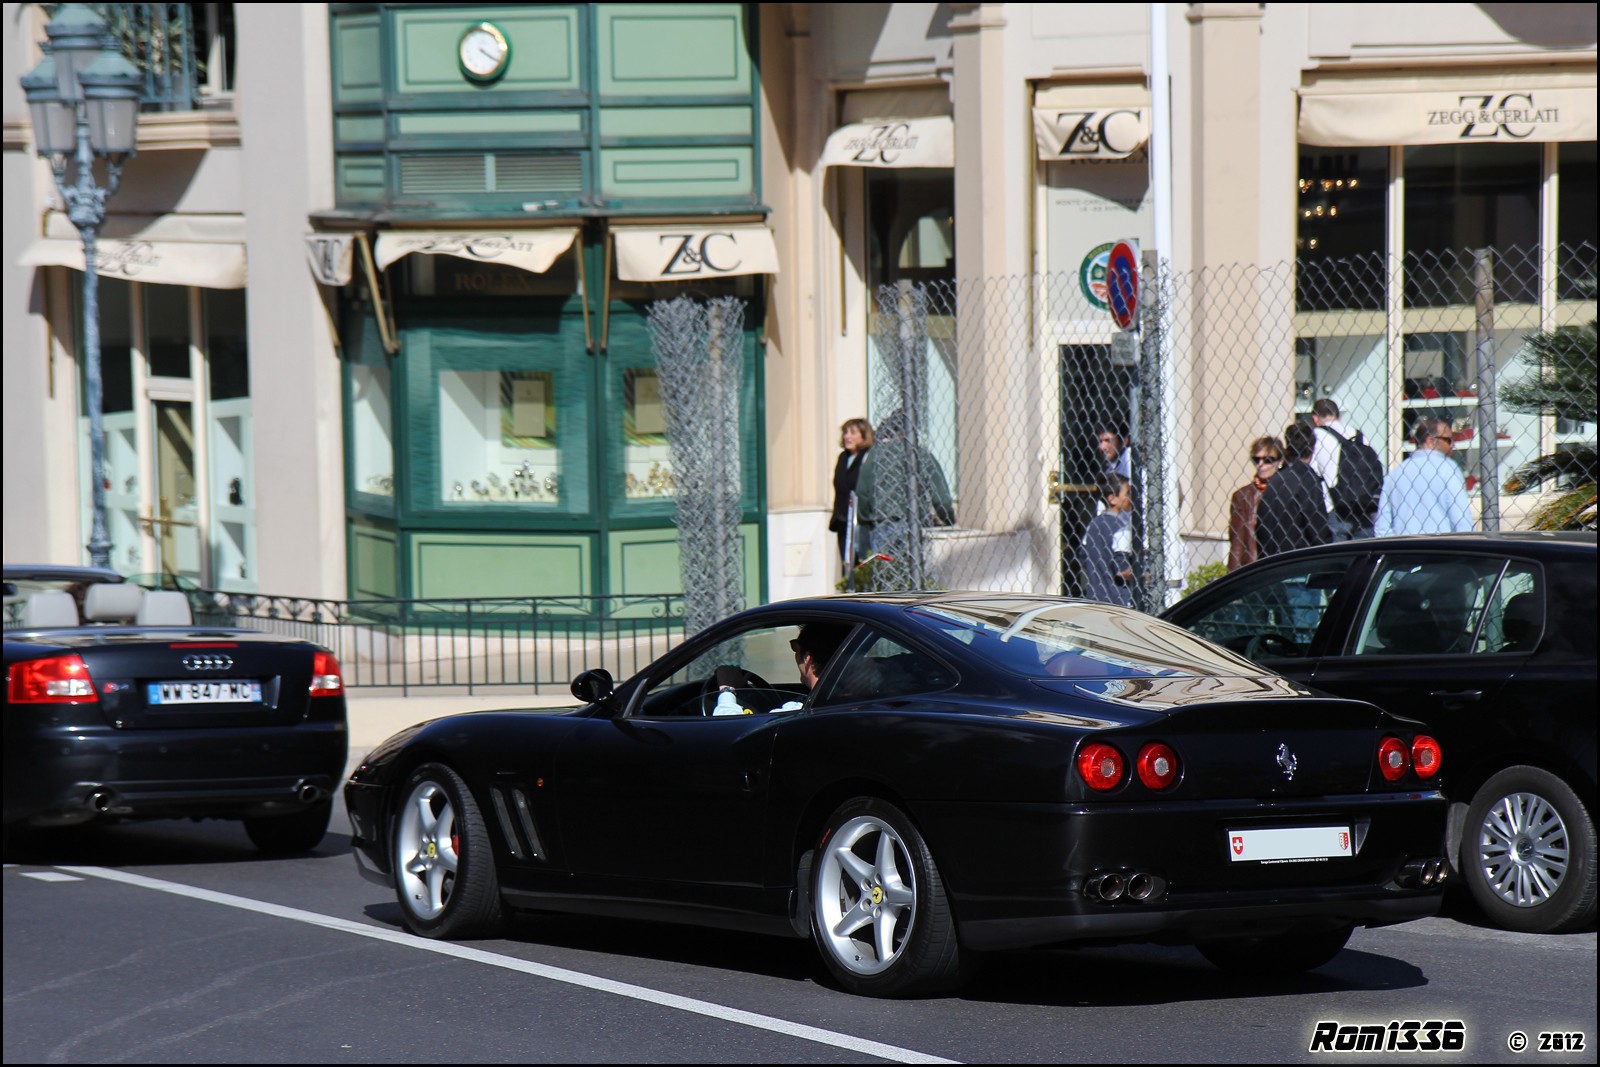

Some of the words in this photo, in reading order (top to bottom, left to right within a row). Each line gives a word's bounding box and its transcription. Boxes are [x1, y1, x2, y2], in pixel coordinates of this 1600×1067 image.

[1057, 110, 1142, 155] Z&C
[1427, 109, 1475, 126] ZEGG
[1492, 108, 1560, 124] CERLATI
[659, 231, 742, 275] Z&C
